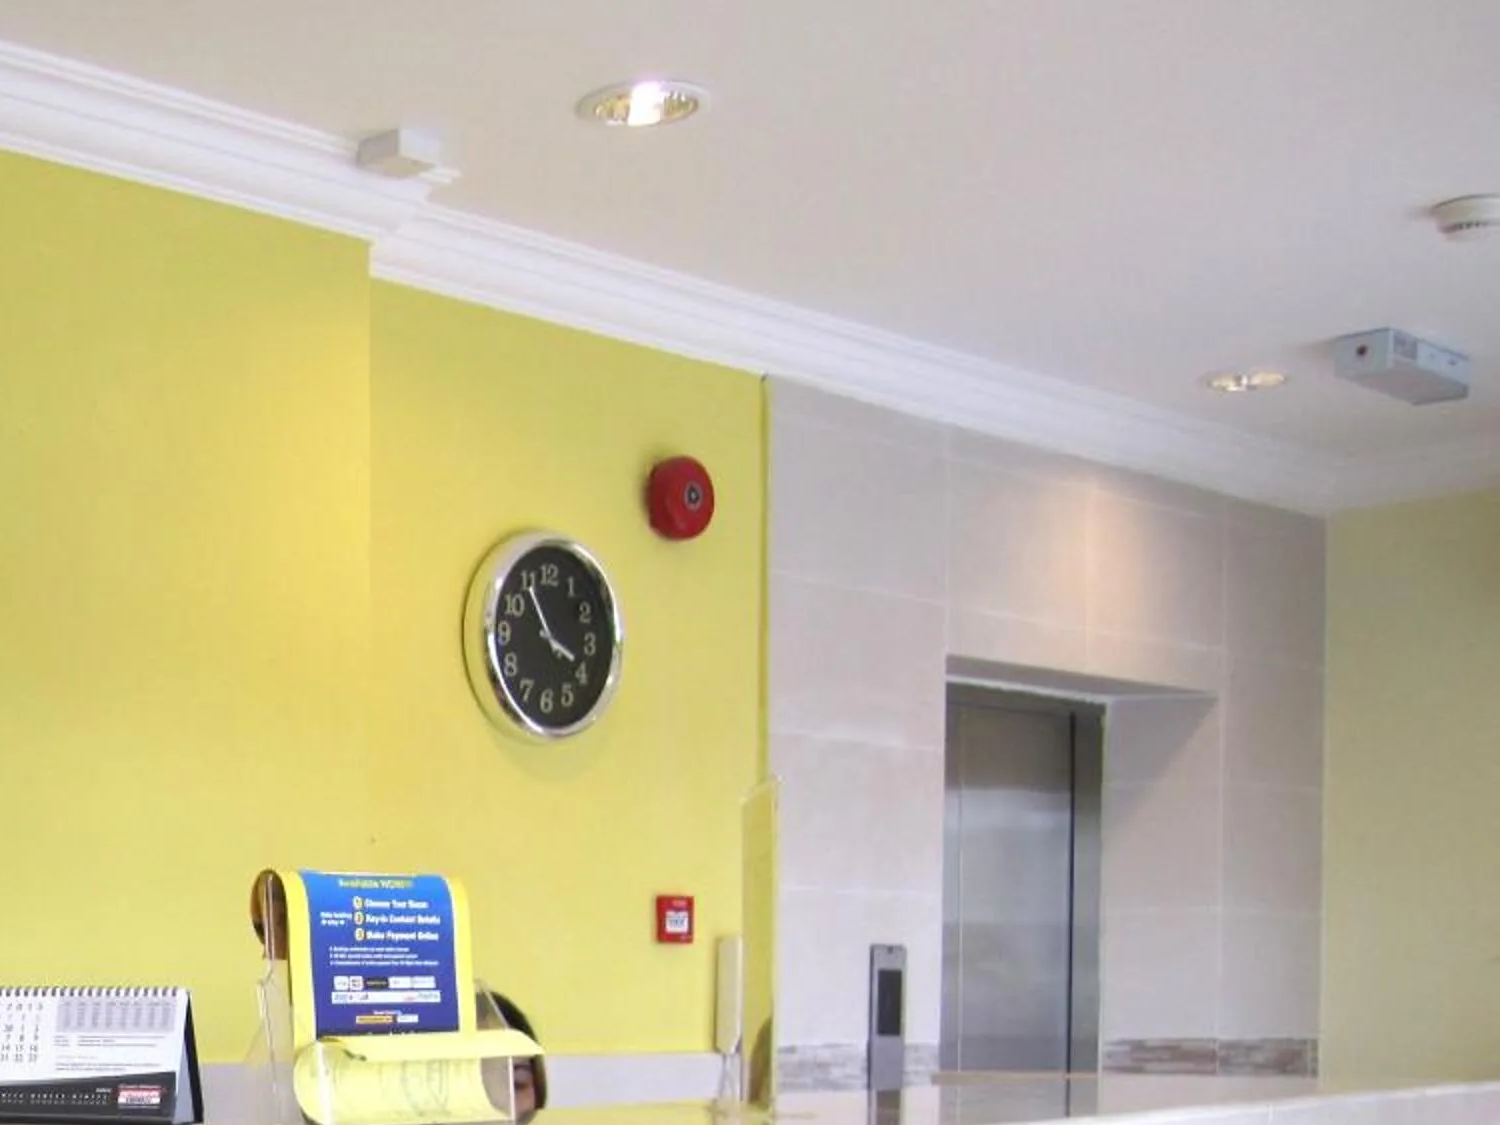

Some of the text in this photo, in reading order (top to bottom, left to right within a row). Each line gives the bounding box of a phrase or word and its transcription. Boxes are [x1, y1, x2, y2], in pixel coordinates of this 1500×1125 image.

[521, 570, 535, 590] 11
[540, 564, 558, 585] 12
[568, 577, 574, 596] 1
[504, 594, 524, 616] 10
[579, 603, 591, 622] 2
[498, 622, 511, 645] 9
[584, 634, 595, 655] 3
[504, 654, 517, 676] 8
[575, 663, 587, 684] 4
[520, 680, 534, 701] 7
[540, 690, 553, 712] 6
[562, 684, 573, 706] 5
